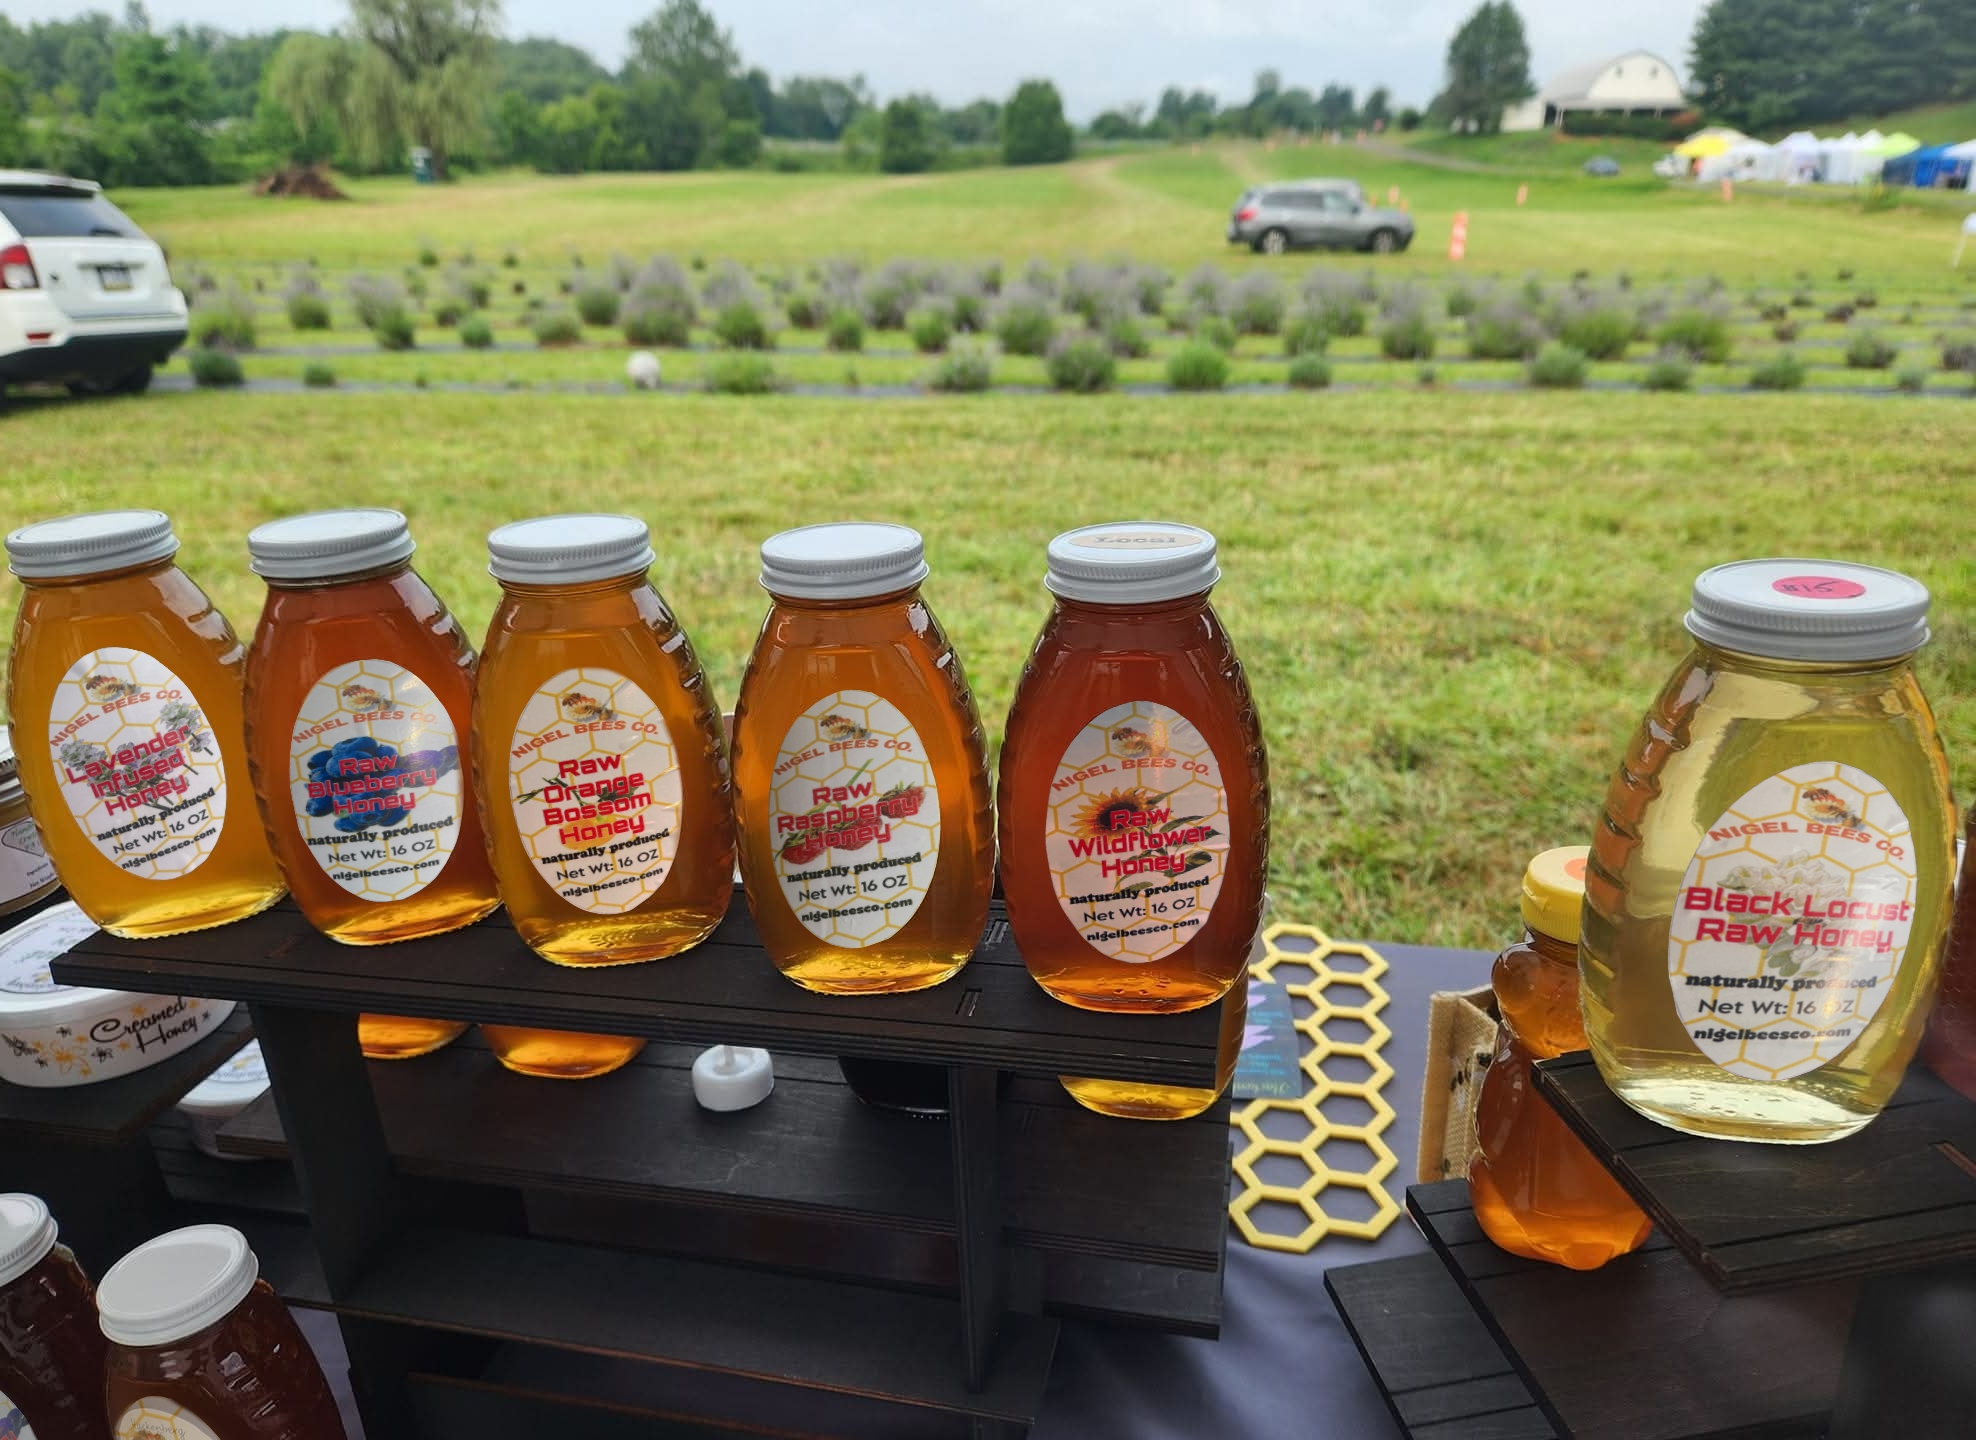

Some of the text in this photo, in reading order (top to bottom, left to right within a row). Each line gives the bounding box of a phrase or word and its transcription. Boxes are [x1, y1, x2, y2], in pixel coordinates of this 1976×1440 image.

[50, 689, 182, 747] NIGEL BEES CO.
[293, 710, 438, 743] NIGEL BEES CO.
[512, 720, 659, 758] NIGEL BEES CO.
[66, 725, 189, 784] Lavender
[339, 755, 398, 776] Raw
[558, 754, 621, 779] Raw
[774, 738, 913, 776] NIGEL BEES CO.
[90, 748, 185, 800] Infused
[307, 768, 437, 798] Blueberry
[543, 772, 644, 803] Orange
[1051, 758, 1209, 792] NIGEL BEES CO.
[105, 774, 188, 816] Honey
[333, 792, 416, 815] Honey
[812, 781, 872, 805] Raw
[96, 788, 216, 842] naturally produced
[543, 793, 651, 825] Bossom
[777, 796, 919, 833] Raspberry
[1110, 808, 1171, 830] Raw
[112, 810, 209, 854] Net Wt: 16 OZ
[307, 816, 453, 846] naturally produced
[559, 814, 645, 844] Honey
[805, 823, 891, 851] Honey
[1068, 826, 1211, 858] Wildflower
[1708, 822, 1905, 860] NIGEL BEES CO.
[122, 826, 216, 870] nigelbeesco.com
[328, 839, 435, 864] Net Wt: 16 OZ
[542, 828, 670, 865] naturally produced
[333, 859, 440, 881] nigelbeesco.com
[556, 849, 659, 881] Net Wt: 16 OZ
[787, 853, 921, 883] naturally produced
[1101, 853, 1186, 878] Honey
[562, 867, 663, 897] nigelbeesco.com
[798, 875, 908, 902] Net Wt: 16 OZ
[1069, 876, 1209, 904] naturally produced
[802, 897, 913, 922] nigelbeesco.com
[1084, 897, 1196, 922] Net Wt: 16 OZ
[1684, 887, 1910, 922] Black Locust
[1087, 918, 1199, 941] nigelbeesco.com
[1696, 918, 1893, 953] Raw Honey
[1686, 974, 1787, 991] naturally
[90, 996, 187, 1043] Creamed
[1698, 999, 1744, 1014] Net
[1751, 1001, 1788, 1015] Wt:
[1796, 1000, 1816, 1014] 16
[136, 1016, 198, 1054] Honey
[1694, 1028, 1851, 1042] nigelbeesco.com
